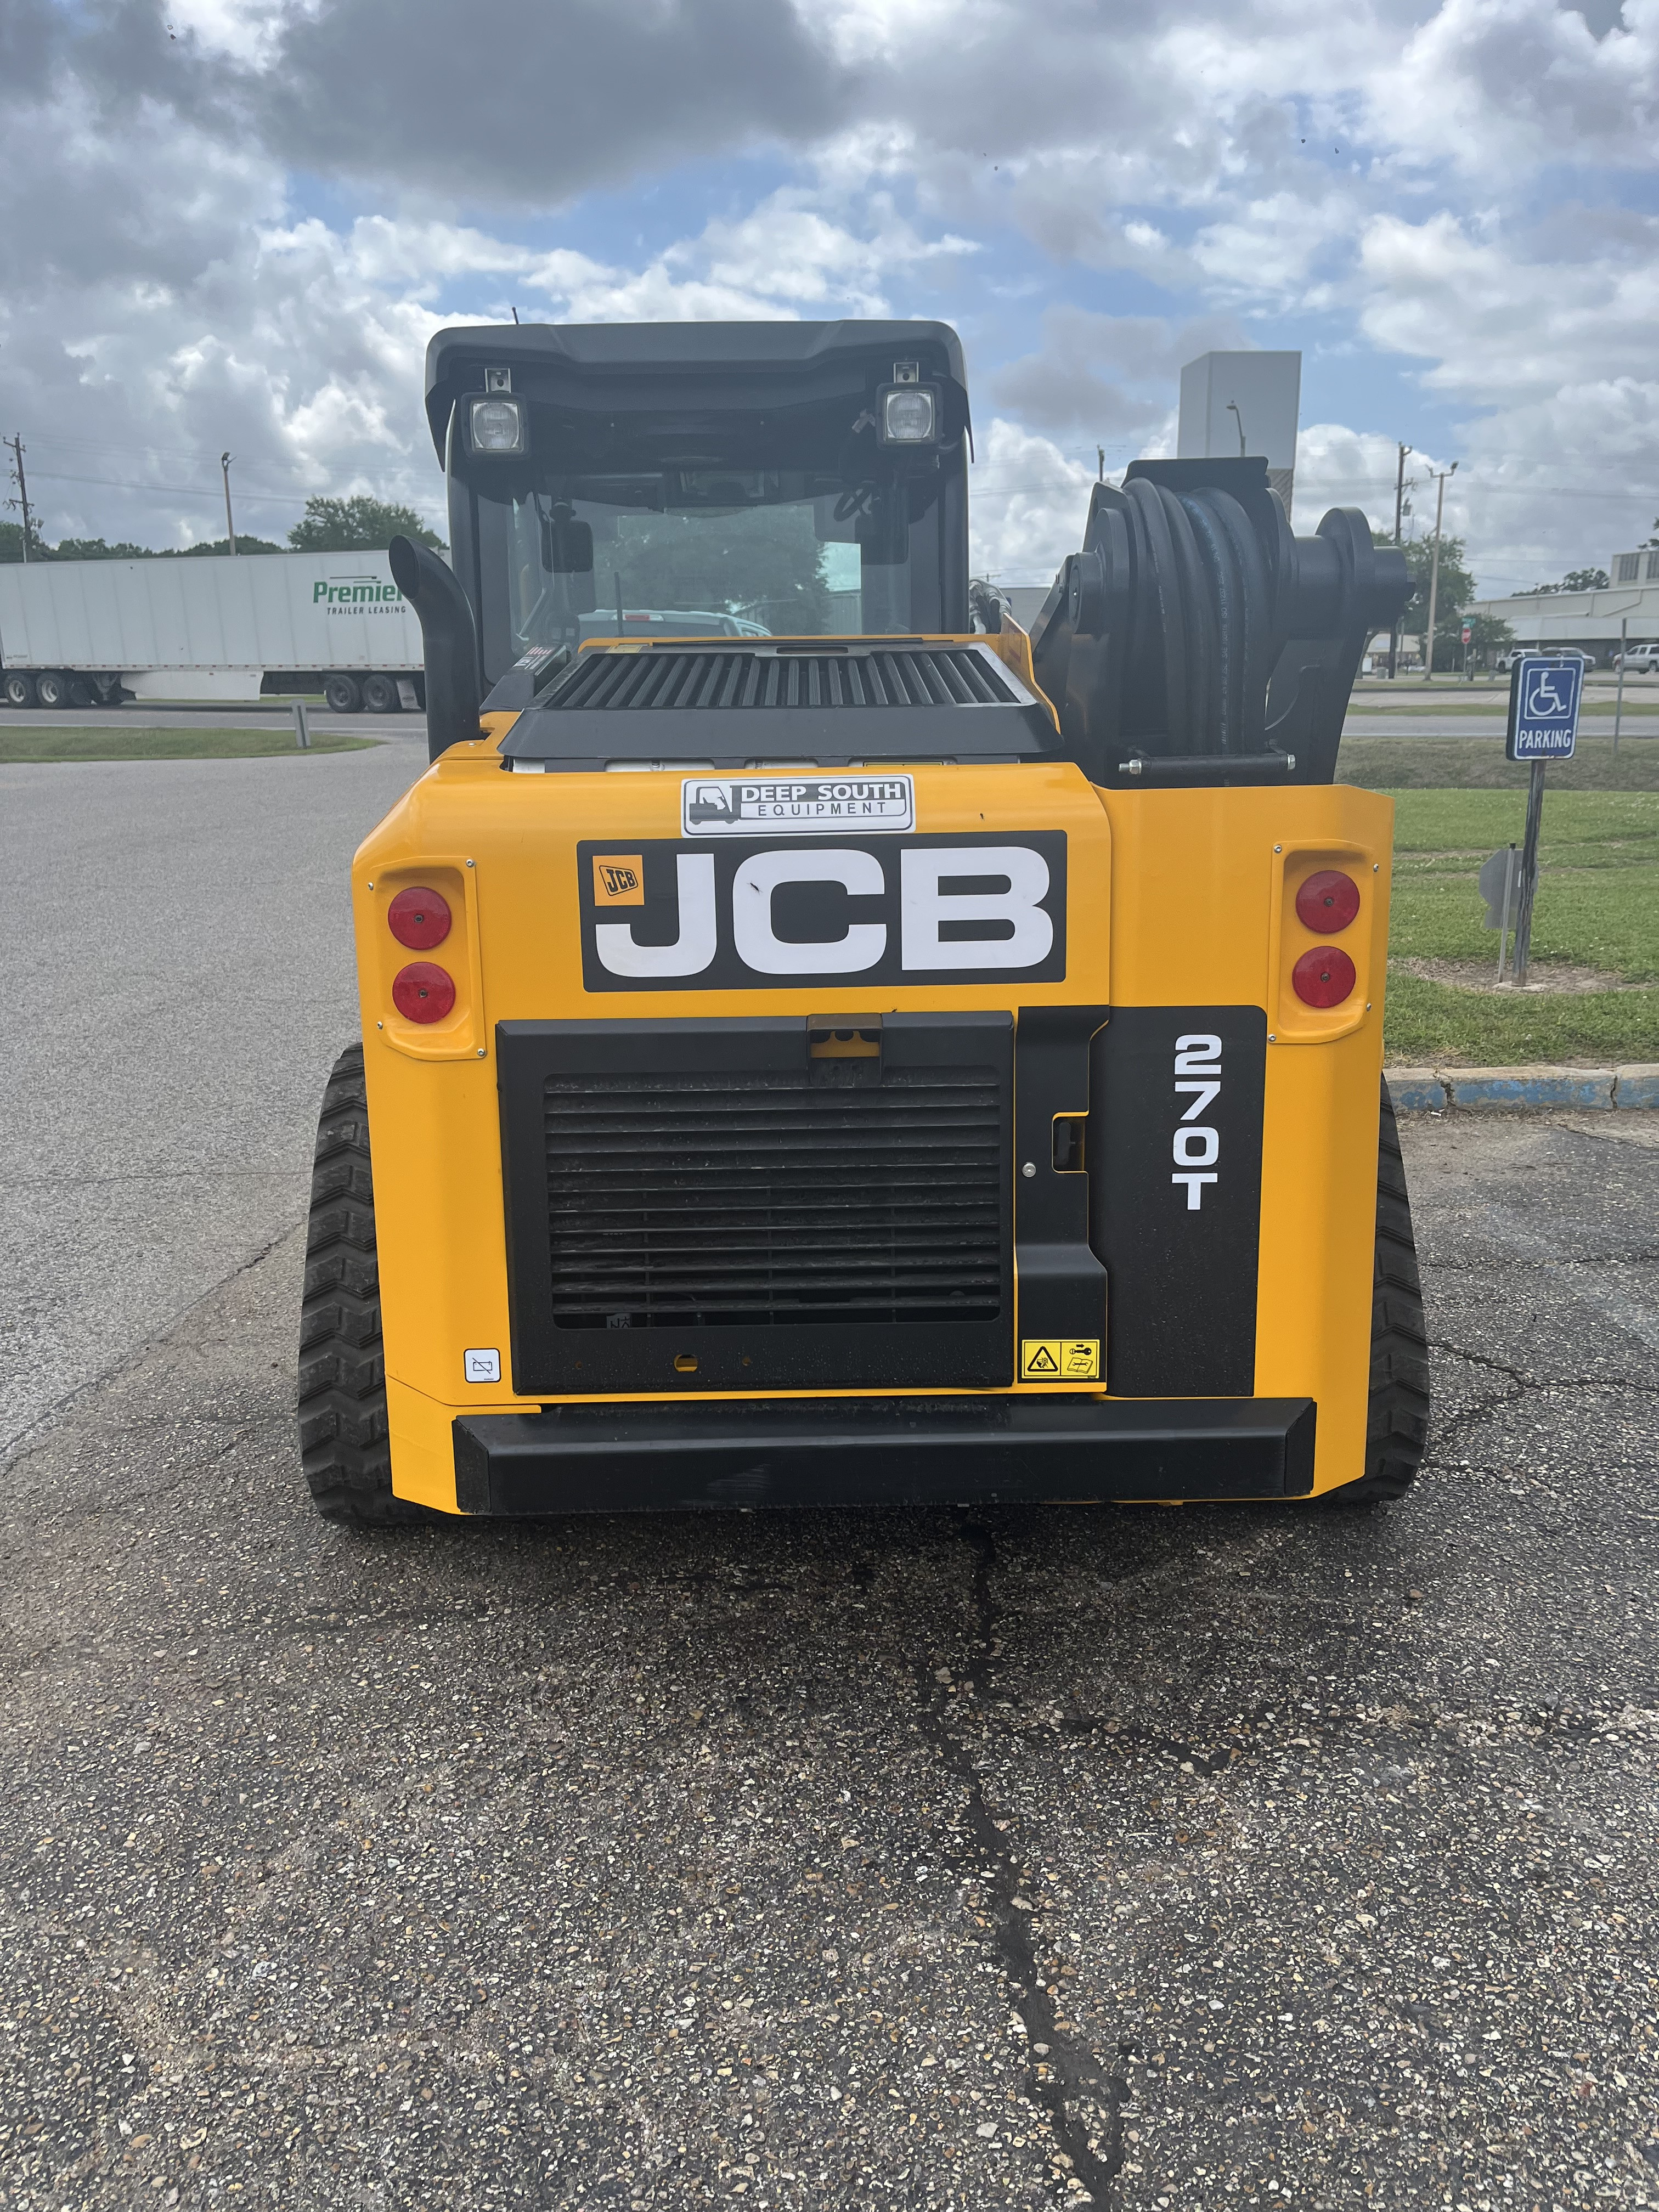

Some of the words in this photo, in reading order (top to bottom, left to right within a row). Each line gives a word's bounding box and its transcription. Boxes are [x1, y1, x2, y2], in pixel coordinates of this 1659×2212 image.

[1218, 588, 1227, 606] 11237
[327, 607, 364, 615] TRAILER
[369, 606, 407, 614] LEASING
[1519, 729, 1572, 749] PARKING
[741, 786, 806, 802] DEEP
[817, 783, 901, 800] SOUTH
[758, 802, 885, 816] EQUIPMENT
[606, 869, 636, 893] JCB
[596, 846, 1053, 978] JCB
[1172, 1034, 1222, 1210] 270T
